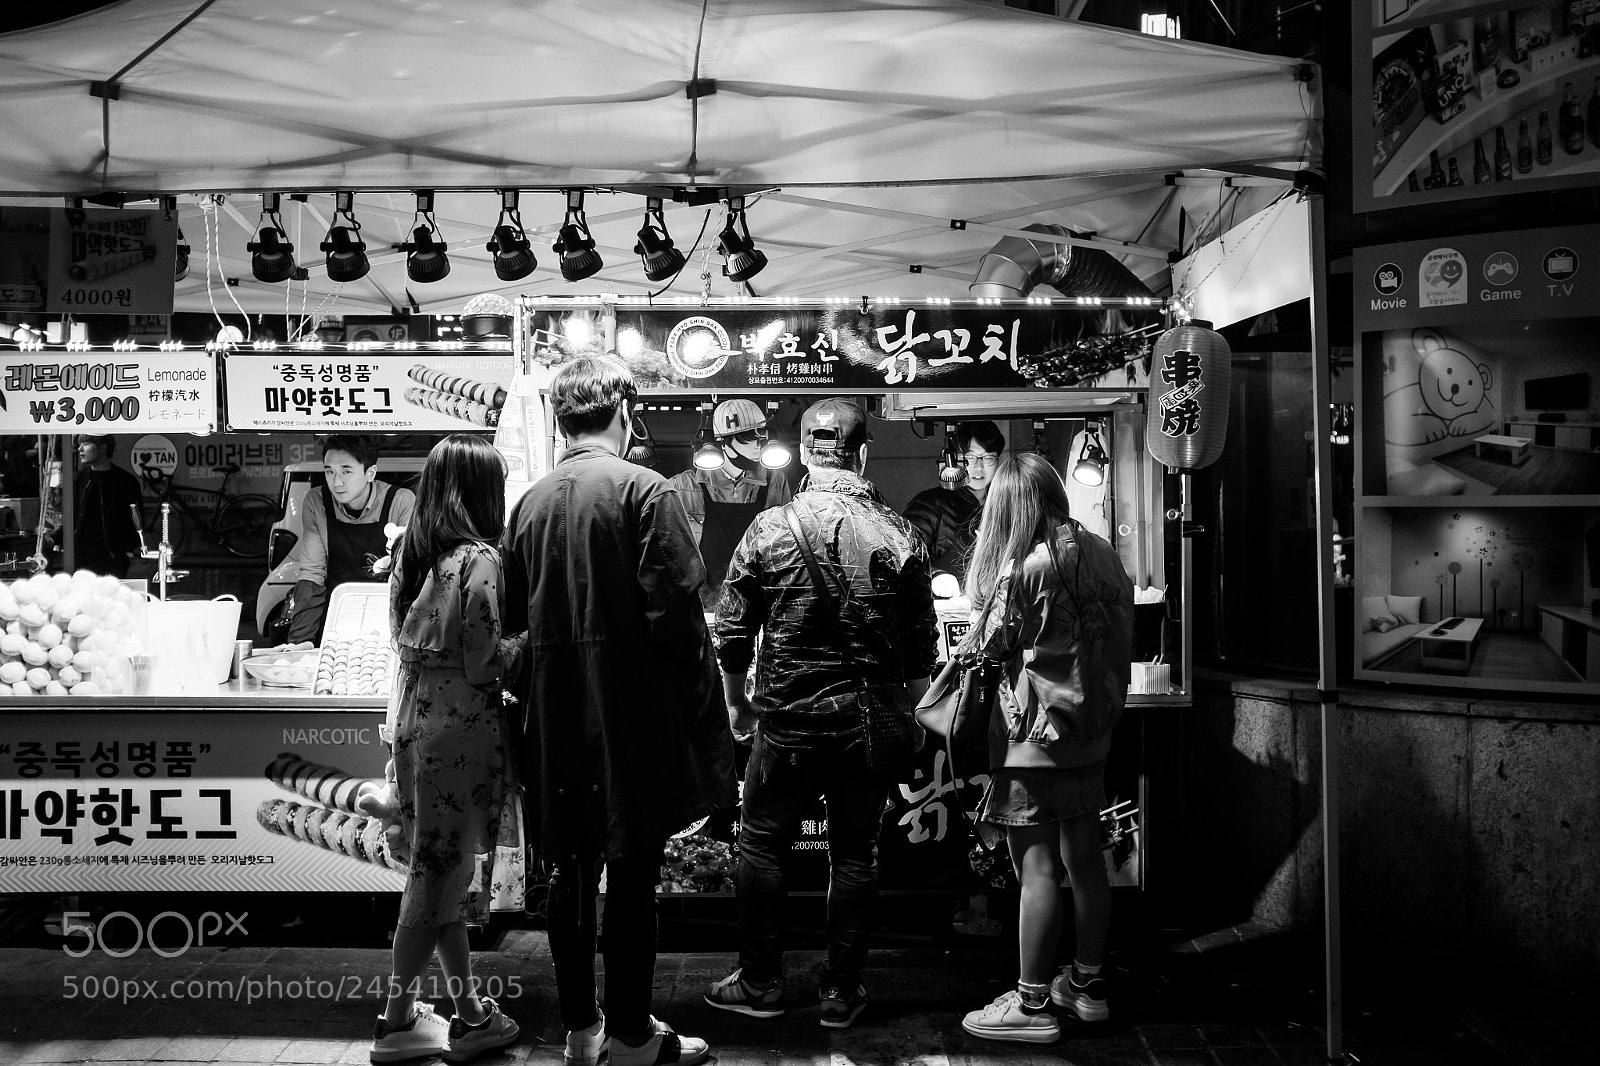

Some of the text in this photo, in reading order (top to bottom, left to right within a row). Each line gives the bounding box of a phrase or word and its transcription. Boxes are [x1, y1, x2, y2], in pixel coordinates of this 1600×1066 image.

[61, 288, 132, 307] 4000원
[1480, 288, 1522, 302] Game
[1546, 283, 1574, 298] T.V
[1370, 297, 1407, 311] Movie
[875, 310, 1021, 384] 닭꼬치
[475, 361, 513, 370] HOTDOG
[4, 363, 141, 392] 레몬에이드
[147, 367, 207, 382] Lemonade
[148, 389, 200, 402] 柠檬汽水
[264, 387, 393, 417] 마약핫도그
[29, 396, 140, 425] ₩3,000
[147, 408, 206, 420] レモネード
[726, 413, 739, 428] H
[154, 451, 175, 464] TAN
[289, 444, 315, 463] 3F
[282, 728, 370, 745] NARCOTIC
[187, 855, 206, 866] 만든
